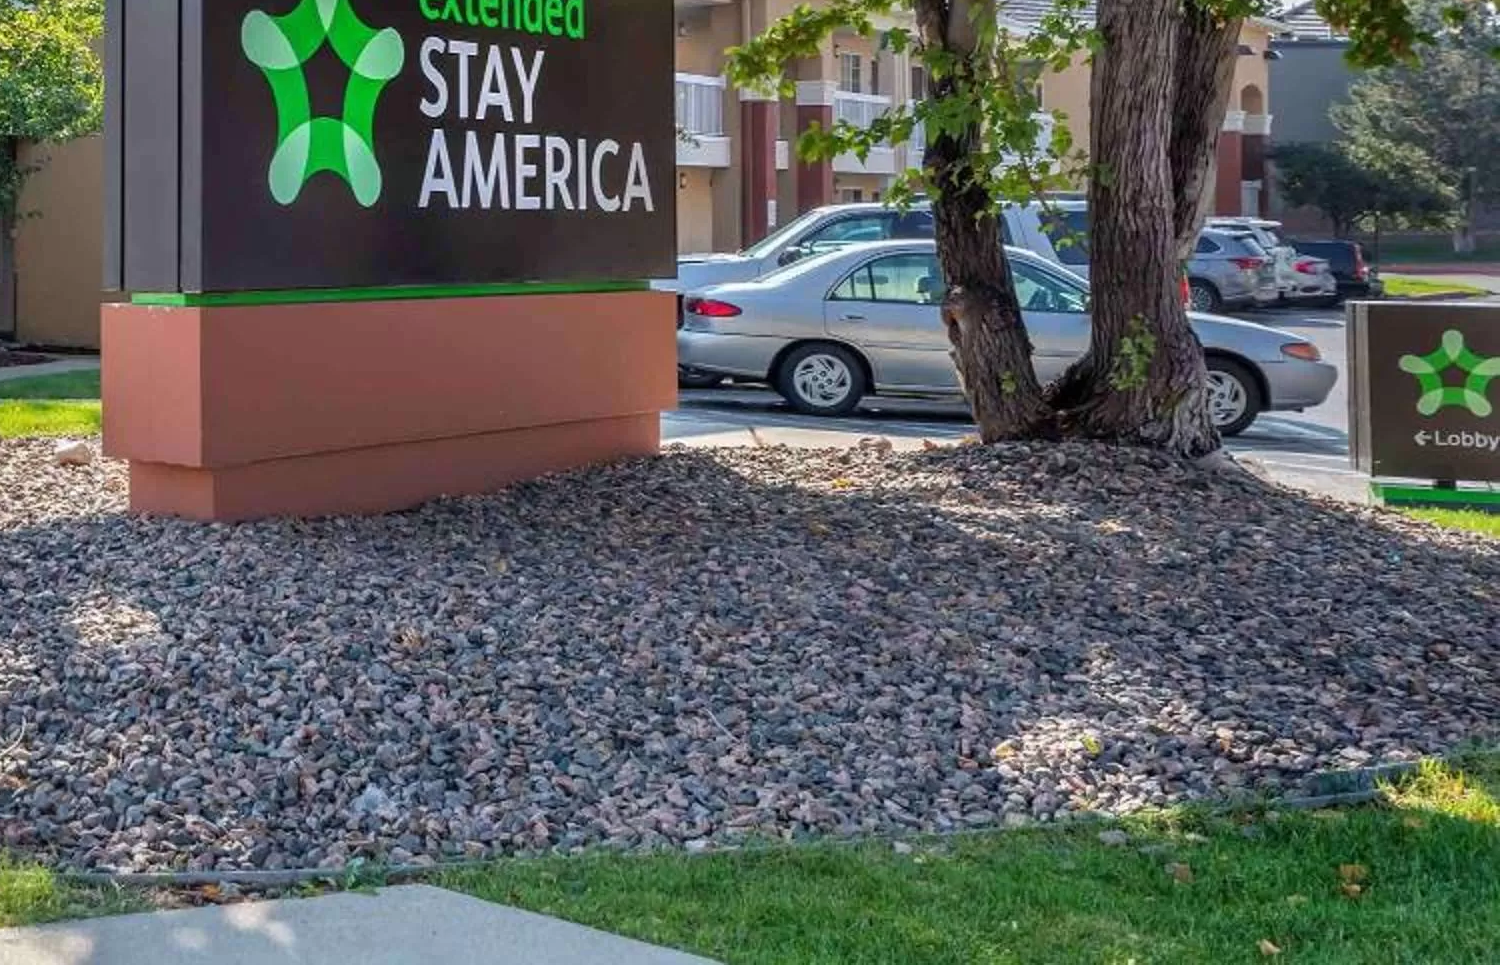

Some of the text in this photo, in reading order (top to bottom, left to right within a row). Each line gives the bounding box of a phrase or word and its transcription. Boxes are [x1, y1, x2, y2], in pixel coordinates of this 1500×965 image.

[419, 36, 545, 123] STAY
[417, 129, 655, 212] AMERICA
[1434, 430, 1500, 452] Lobby
